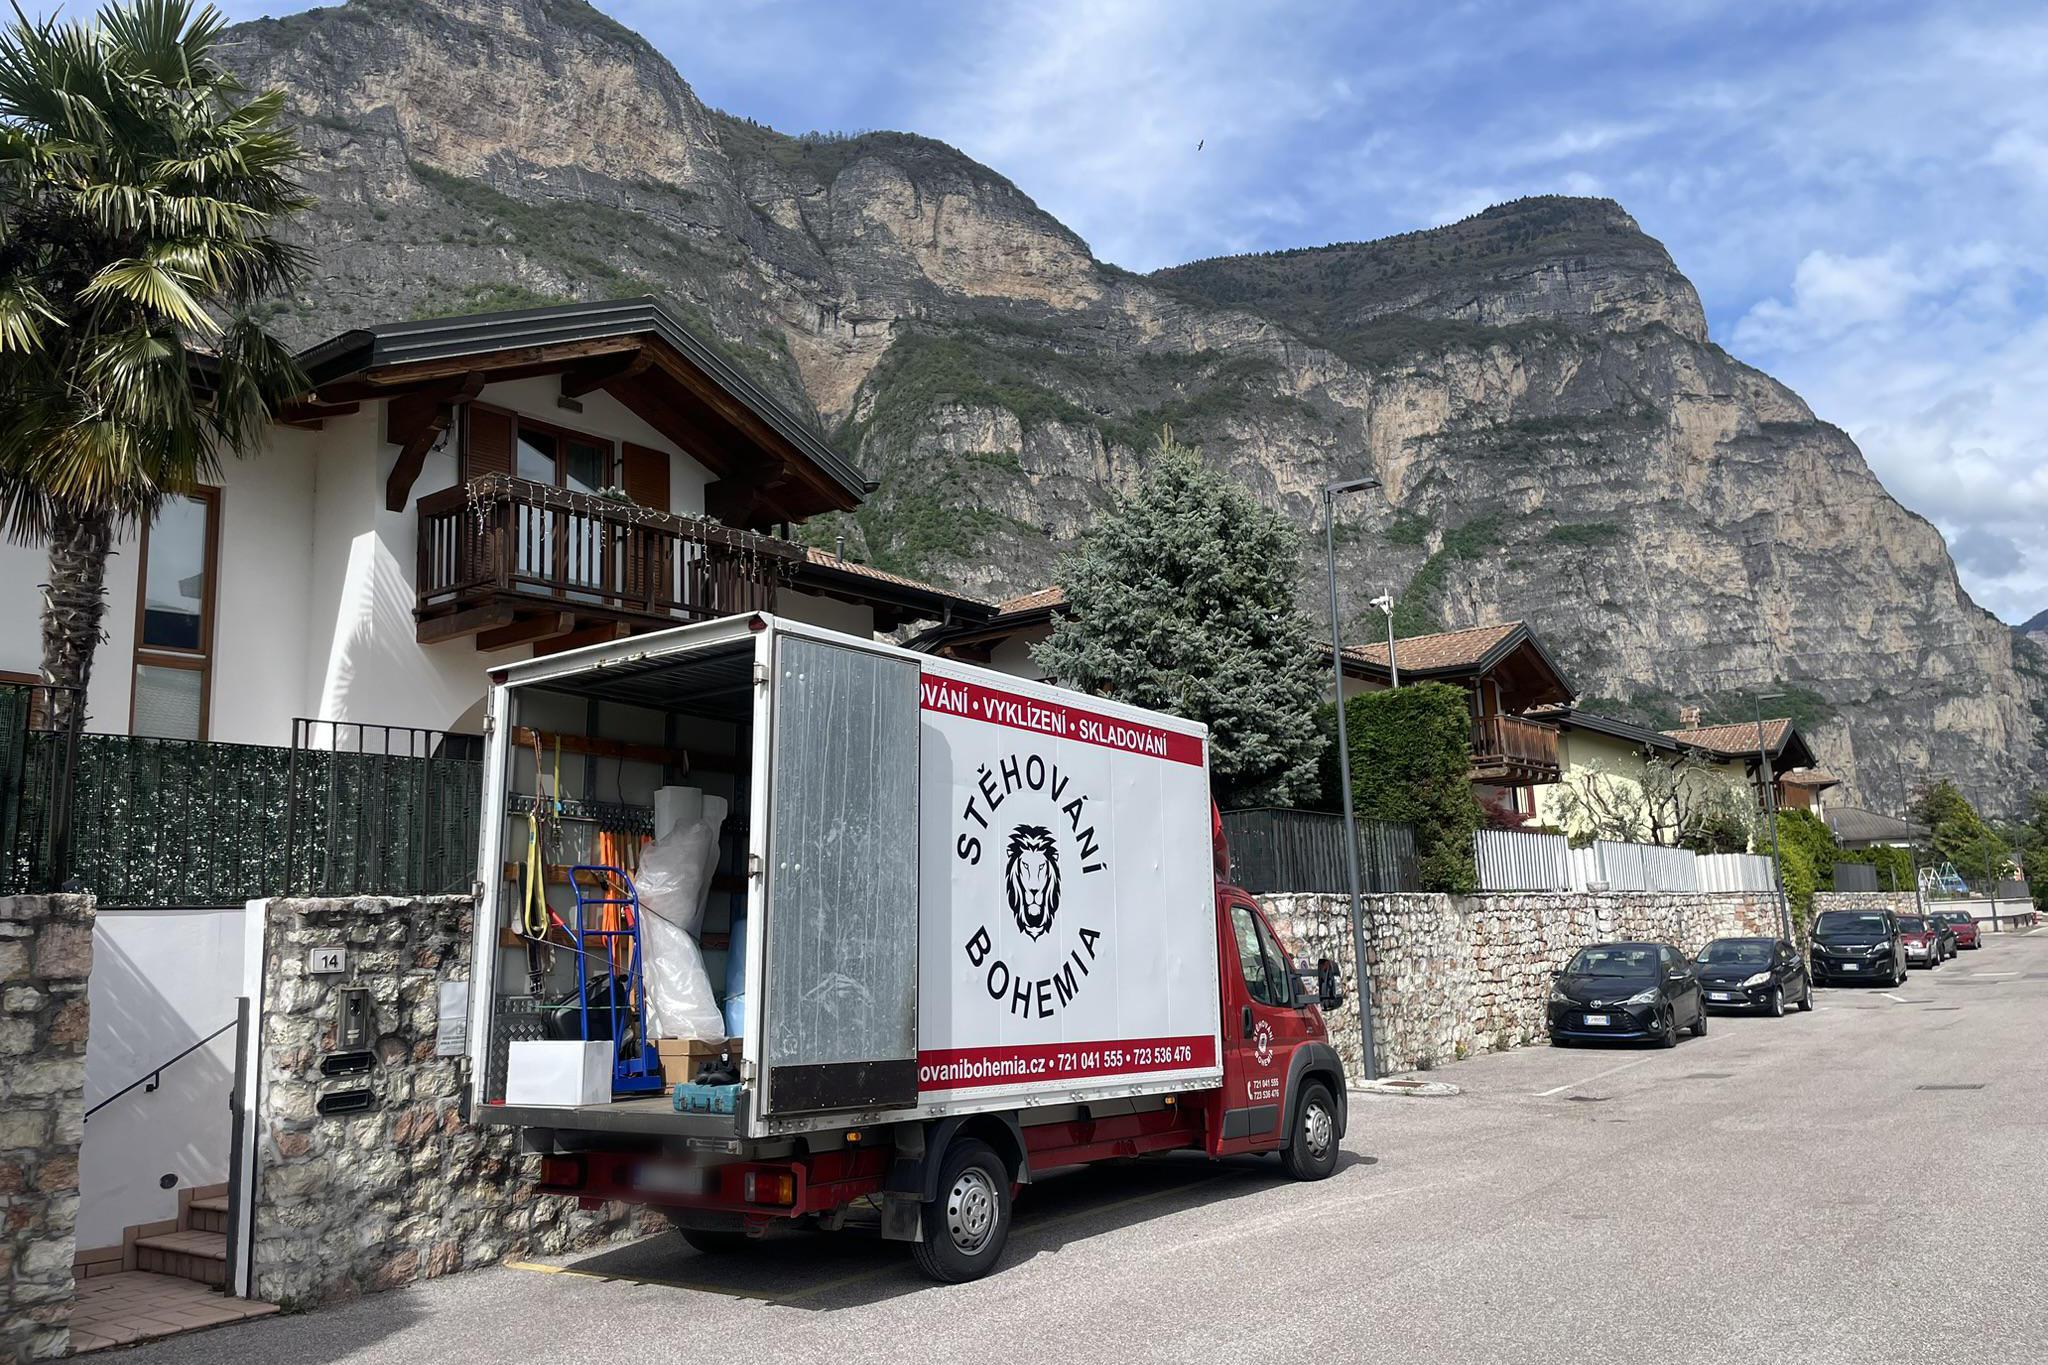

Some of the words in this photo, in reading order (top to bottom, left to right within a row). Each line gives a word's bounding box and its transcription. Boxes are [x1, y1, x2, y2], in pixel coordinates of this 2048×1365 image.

[982, 697, 1067, 735] VYKLÍZENÍ
[1079, 719, 1168, 756] SKLADOVÁNÍ
[957, 754, 1107, 874] STĚHOVÁNÍ
[321, 954, 339, 968] 14
[965, 925, 1101, 1019] BOHEMIA
[918, 1056, 1046, 1082] ovanibohemia.cz
[1057, 1052, 1078, 1071] 721
[1081, 1051, 1100, 1070] 041
[1104, 1050, 1123, 1068] 555
[1133, 1047, 1152, 1065] 723
[1154, 1046, 1172, 1063] 536
[1174, 1045, 1191, 1062] 476
